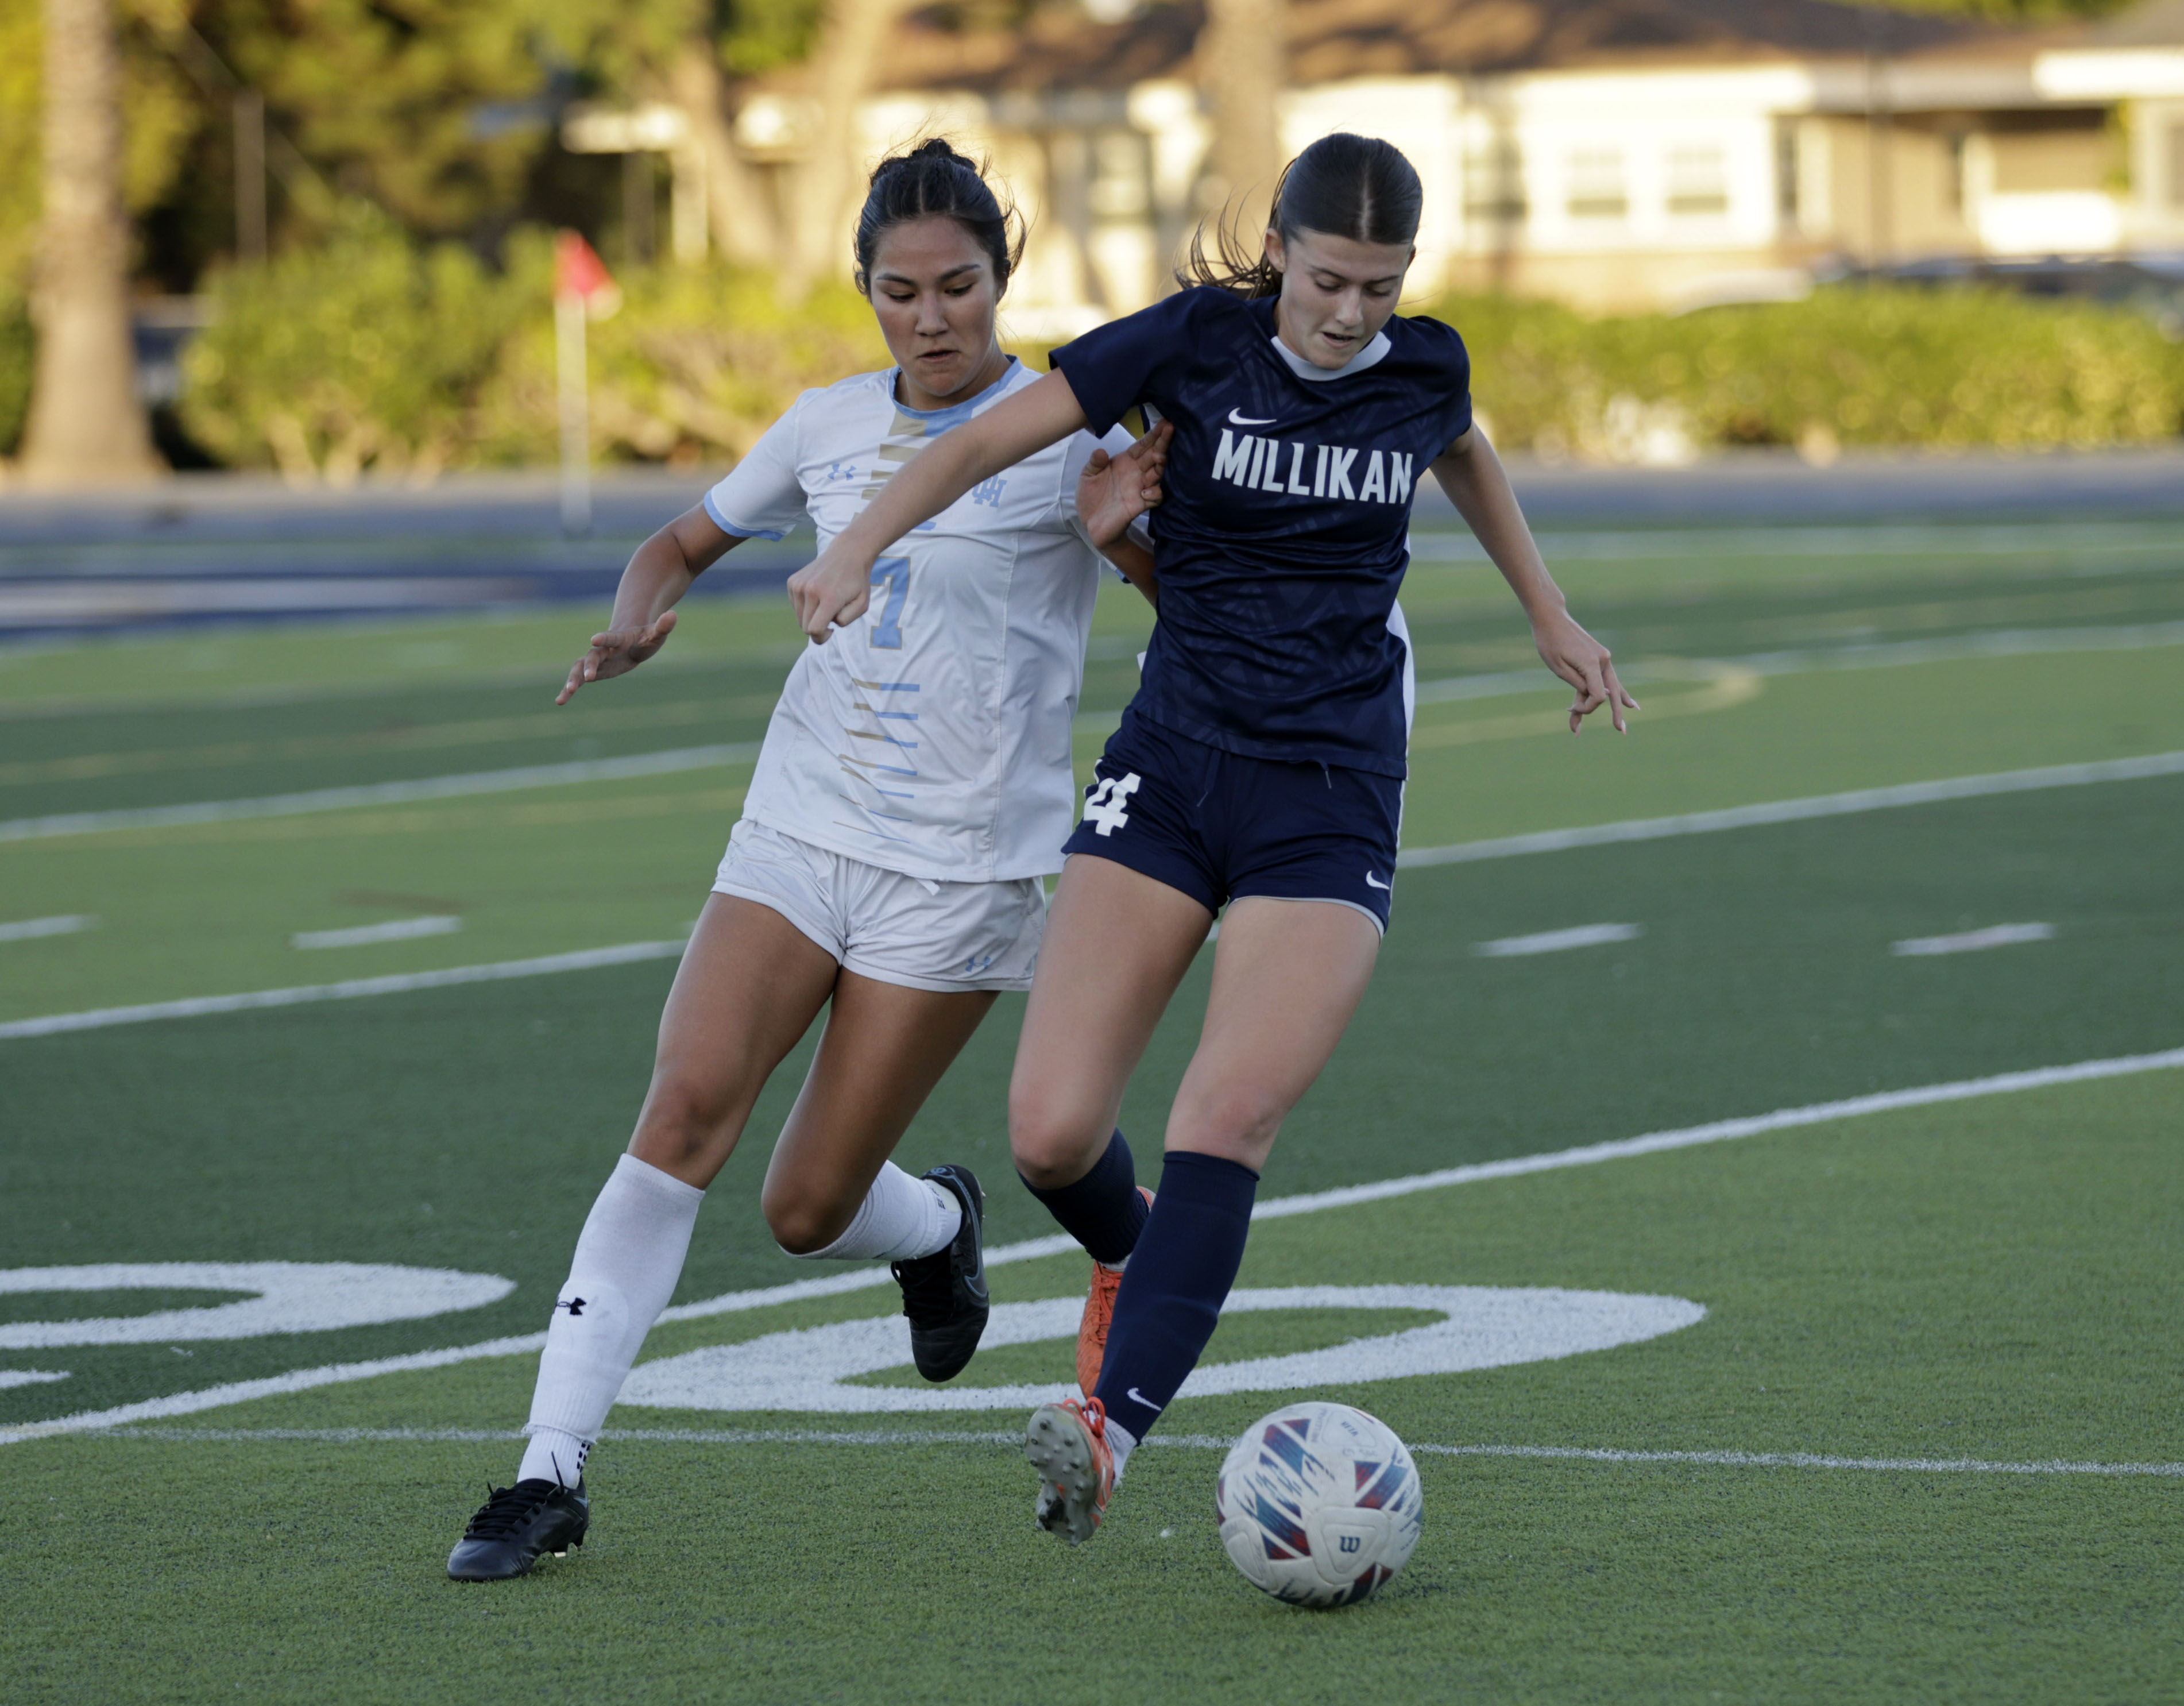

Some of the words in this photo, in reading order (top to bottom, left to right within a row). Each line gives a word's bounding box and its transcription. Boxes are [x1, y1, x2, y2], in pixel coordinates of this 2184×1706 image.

[1211, 428, 1413, 504] MILLIKAN
[869, 555, 911, 650] 7
[1083, 772, 1141, 837] 4
